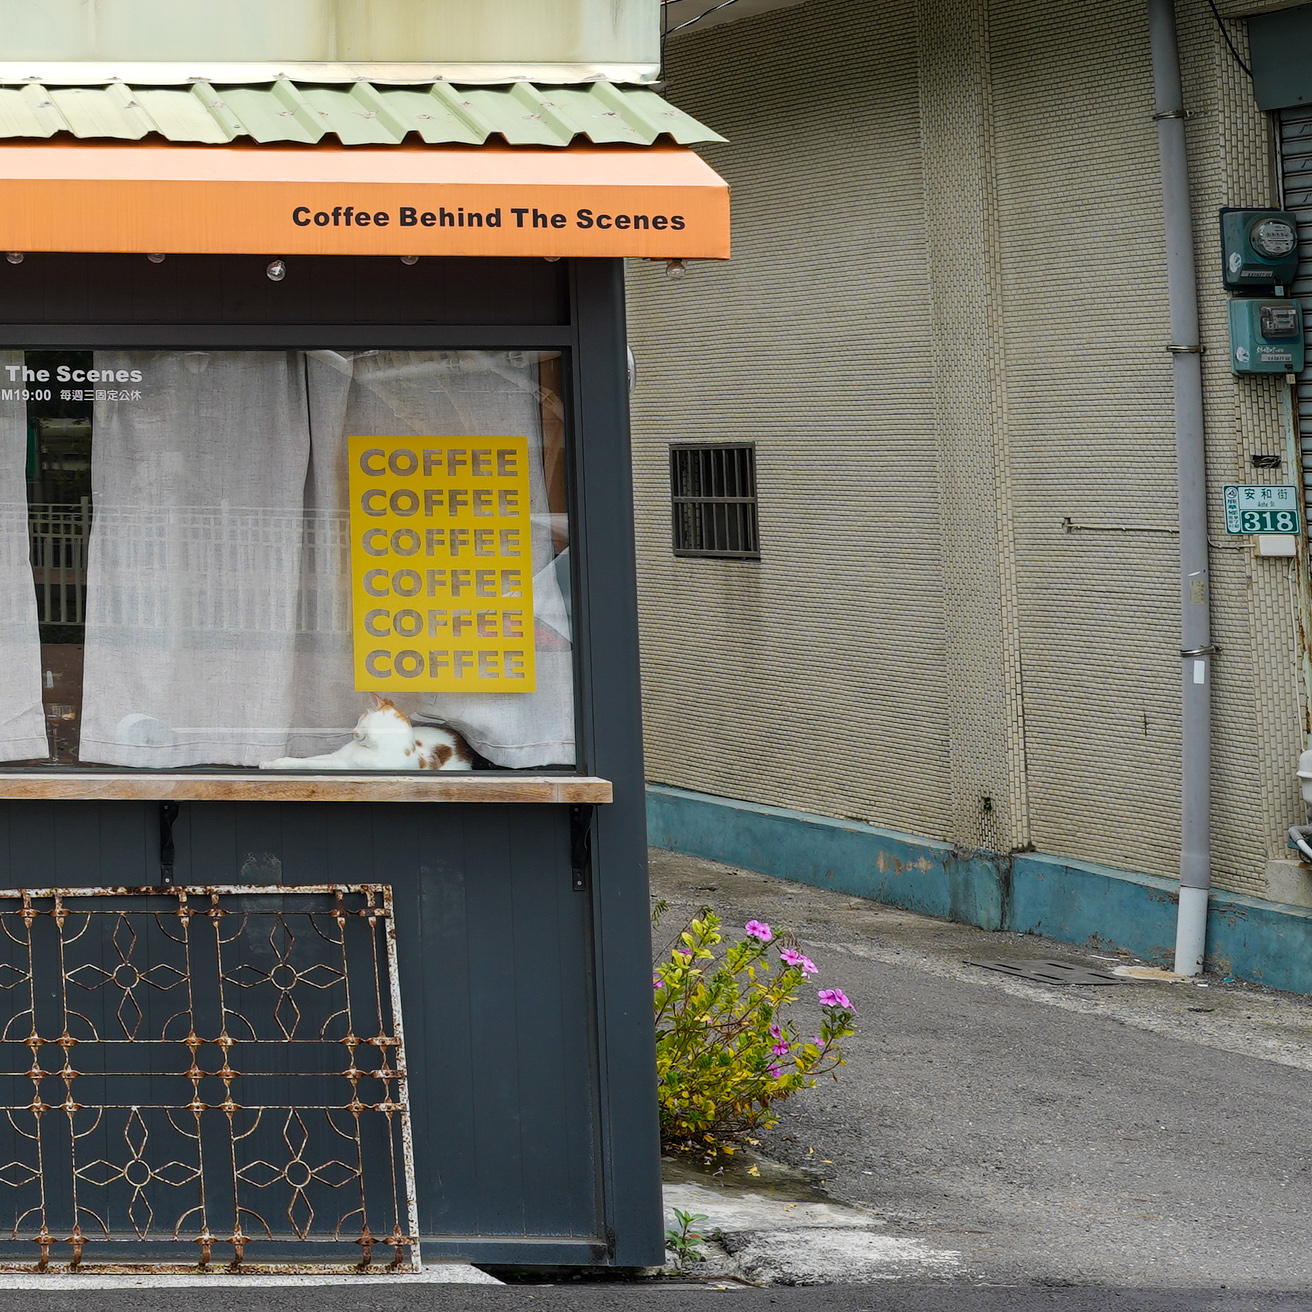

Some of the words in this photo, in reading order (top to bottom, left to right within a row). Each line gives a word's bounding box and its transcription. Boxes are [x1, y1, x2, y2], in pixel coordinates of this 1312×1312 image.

[292, 206, 390, 227] Coffee
[399, 206, 502, 228] Behind
[510, 207, 567, 229] The
[576, 208, 686, 231] Scenes
[5, 366, 50, 382] The
[56, 365, 143, 383] Scenes
[58, 388, 143, 402] 每週三固定公休
[359, 448, 519, 477] COFFEE
[360, 488, 520, 517] COFFEE
[1244, 488, 1288, 500] 安和街
[1244, 511, 1293, 531] 318
[361, 528, 521, 557] COFFEE
[362, 568, 523, 597] COFFEE
[364, 608, 524, 637] COFFEE
[365, 649, 525, 678] COFFEE
